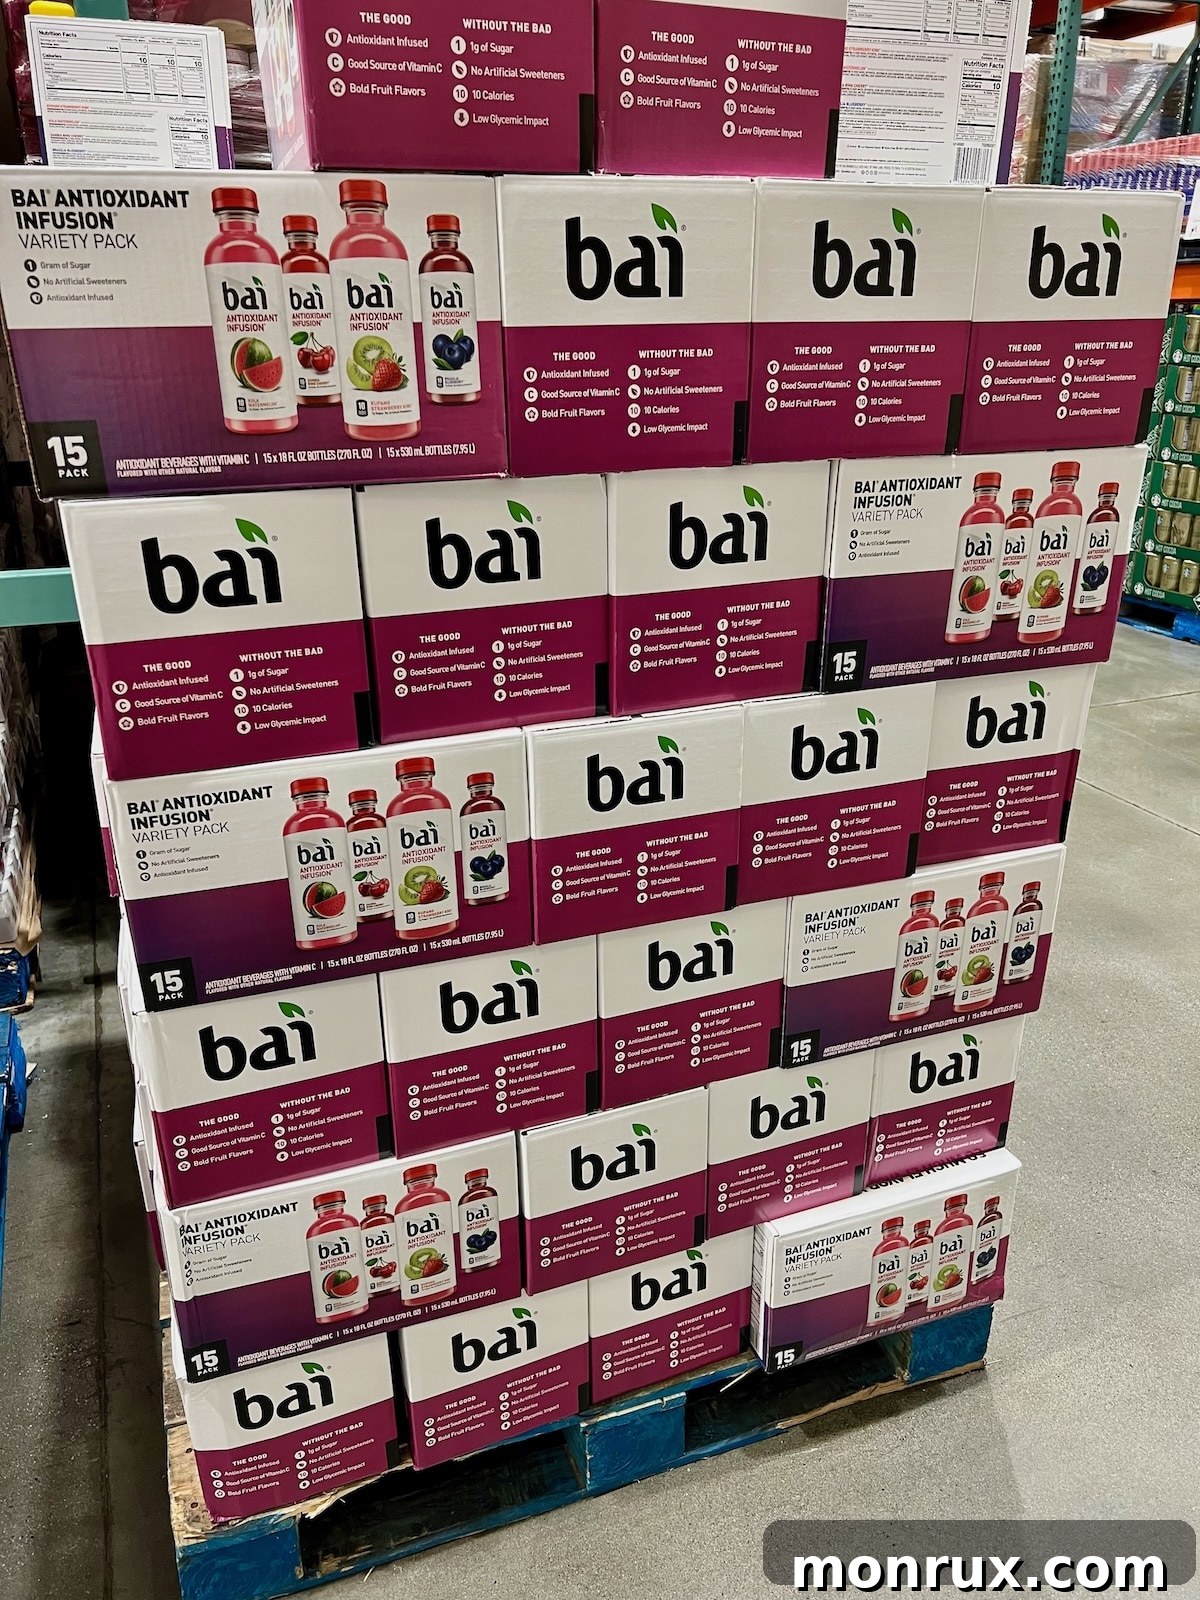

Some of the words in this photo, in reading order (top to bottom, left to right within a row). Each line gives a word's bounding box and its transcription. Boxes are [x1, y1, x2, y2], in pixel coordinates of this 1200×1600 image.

[359, 11, 380, 23] THE
[382, 13, 411, 25] GOOD
[462, 18, 508, 31] WITHOUT
[510, 21, 529, 32] THE
[531, 22, 551, 34] BAD
[346, 33, 395, 46] Antioxidant
[396, 36, 428, 47] Infused
[470, 41, 479, 54] 1g
[480, 41, 488, 52] of
[489, 42, 514, 55] Sugar
[347, 58, 368, 69] Good
[369, 59, 397, 71] Source
[397, 61, 406, 71] of
[405, 61, 436, 72] Vitamin
[436, 62, 442, 73] C
[470, 65, 482, 75] No
[483, 66, 518, 77] Artificial
[519, 68, 565, 80] Sweeteners
[963, 60, 988, 68] Nutrition
[989, 61, 1004, 69] Facts
[349, 82, 369, 93] Bold
[371, 83, 393, 95] Fruit
[394, 84, 426, 96] Flavors
[472, 89, 481, 99] 10
[482, 90, 514, 101] Calories
[472, 113, 489, 123] Low
[489, 113, 523, 126] Glycemic
[523, 115, 549, 127] Impact
[10, 188, 50, 207] BAI
[54, 189, 189, 208] ANTIOXIDANT
[15, 211, 116, 229] INFUSION
[18, 233, 87, 248] VARIETY
[93, 233, 138, 248] PACK
[566, 204, 683, 300] bai
[813, 208, 916, 298] bai
[1029, 214, 1121, 298] bai
[40, 261, 60, 269] Gram
[69, 261, 91, 270] Sugar
[55, 277, 85, 285] Artificial
[85, 277, 127, 285] Sweeteners
[87, 293, 113, 301] Infused
[222, 276, 268, 310] bai
[289, 283, 324, 310] bai
[347, 272, 394, 309] bai
[430, 282, 463, 308] bai
[227, 314, 278, 322] ANTIOXIDANT
[350, 313, 403, 321] ANTIOXIDANT
[227, 324, 265, 332] INFUSION
[350, 322, 389, 331] INFUSION
[1008, 344, 1022, 352] THE
[1022, 343, 1041, 351] GOOD
[1074, 342, 1105, 350] WITHOUT
[1105, 341, 1119, 349] THE
[1119, 341, 1133, 349] BAD
[996, 359, 1028, 367] Antioxidant
[1028, 358, 1050, 366] Infused
[1081, 374, 1105, 382] Artificial
[1105, 373, 1136, 381] Sweeteners
[991, 394, 1005, 402] Bold
[1005, 393, 1020, 401] Fruit
[1072, 391, 1078, 399] 10
[1077, 391, 1100, 399] Calories
[1068, 408, 1080, 416] Low
[1079, 407, 1102, 416] Glycemic
[1102, 407, 1120, 415] Impact
[46, 435, 87, 466] 15
[262, 453, 272, 463] 15
[272, 454, 278, 463] x
[278, 452, 287, 462] 18
[287, 452, 297, 462] FL
[296, 451, 307, 461] OZ
[306, 450, 336, 461] BOTTLES
[336, 450, 352, 460] (270
[352, 449, 361, 459] FL
[361, 449, 372, 459] OZ)
[386, 446, 395, 457] 15
[394, 449, 400, 457] x
[400, 446, 413, 457] 530
[413, 445, 424, 456] mL
[424, 444, 452, 455] BOTTLES
[452, 443, 468, 455] (7.95
[468, 443, 475, 454] L)
[116, 457, 159, 470] ANTIOXIDANT
[160, 456, 199, 468] BEVERAGES
[198, 455, 217, 466] WITH
[216, 454, 243, 465] VITAMIN
[243, 453, 249, 464] C
[58, 468, 89, 478] PACK
[116, 469, 143, 477] FLAVORED
[143, 468, 157, 476] WITH
[854, 480, 875, 493] BAI
[876, 476, 962, 492] ANTIOXIDANT
[853, 493, 914, 509] INFUSION
[851, 509, 894, 522] VARIETY
[896, 507, 923, 520] PACK
[670, 486, 768, 569] bai
[426, 500, 541, 589] bai
[141, 519, 282, 614] bai
[967, 681, 1046, 748] bai
[791, 708, 878, 780] bai
[587, 736, 683, 812] bai
[126, 799, 159, 815] BAI
[162, 785, 272, 811] ANTIOXIDANT
[130, 808, 212, 830] INFUSION
[131, 826, 188, 843] VARIETY
[193, 821, 229, 836] PACK
[805, 911, 823, 923] BAI
[824, 897, 900, 919] ANTIOXIDANT
[804, 916, 859, 934] INFUSION
[649, 921, 733, 990] bai
[150, 969, 183, 993] 15
[157, 991, 183, 1001] PACK
[440, 960, 538, 1033] bai
[199, 1002, 316, 1081] bai
[910, 1034, 979, 1093] bai
[751, 1077, 825, 1139] bai
[571, 1124, 655, 1190] bai
[785, 1244, 802, 1256] BAI
[802, 1226, 871, 1251] ANTIOXIDANT
[785, 1245, 835, 1265] INFUSION
[632, 1262, 706, 1310] bai
[452, 1308, 537, 1372] bai
[233, 1363, 333, 1429] bai
[301, 1431, 333, 1446] WITHOUT
[334, 1426, 348, 1435] THE
[349, 1421, 363, 1430] BAD
[232, 1458, 246, 1466] THE
[247, 1453, 267, 1462] GOOD
[317, 1460, 340, 1471] Calories
